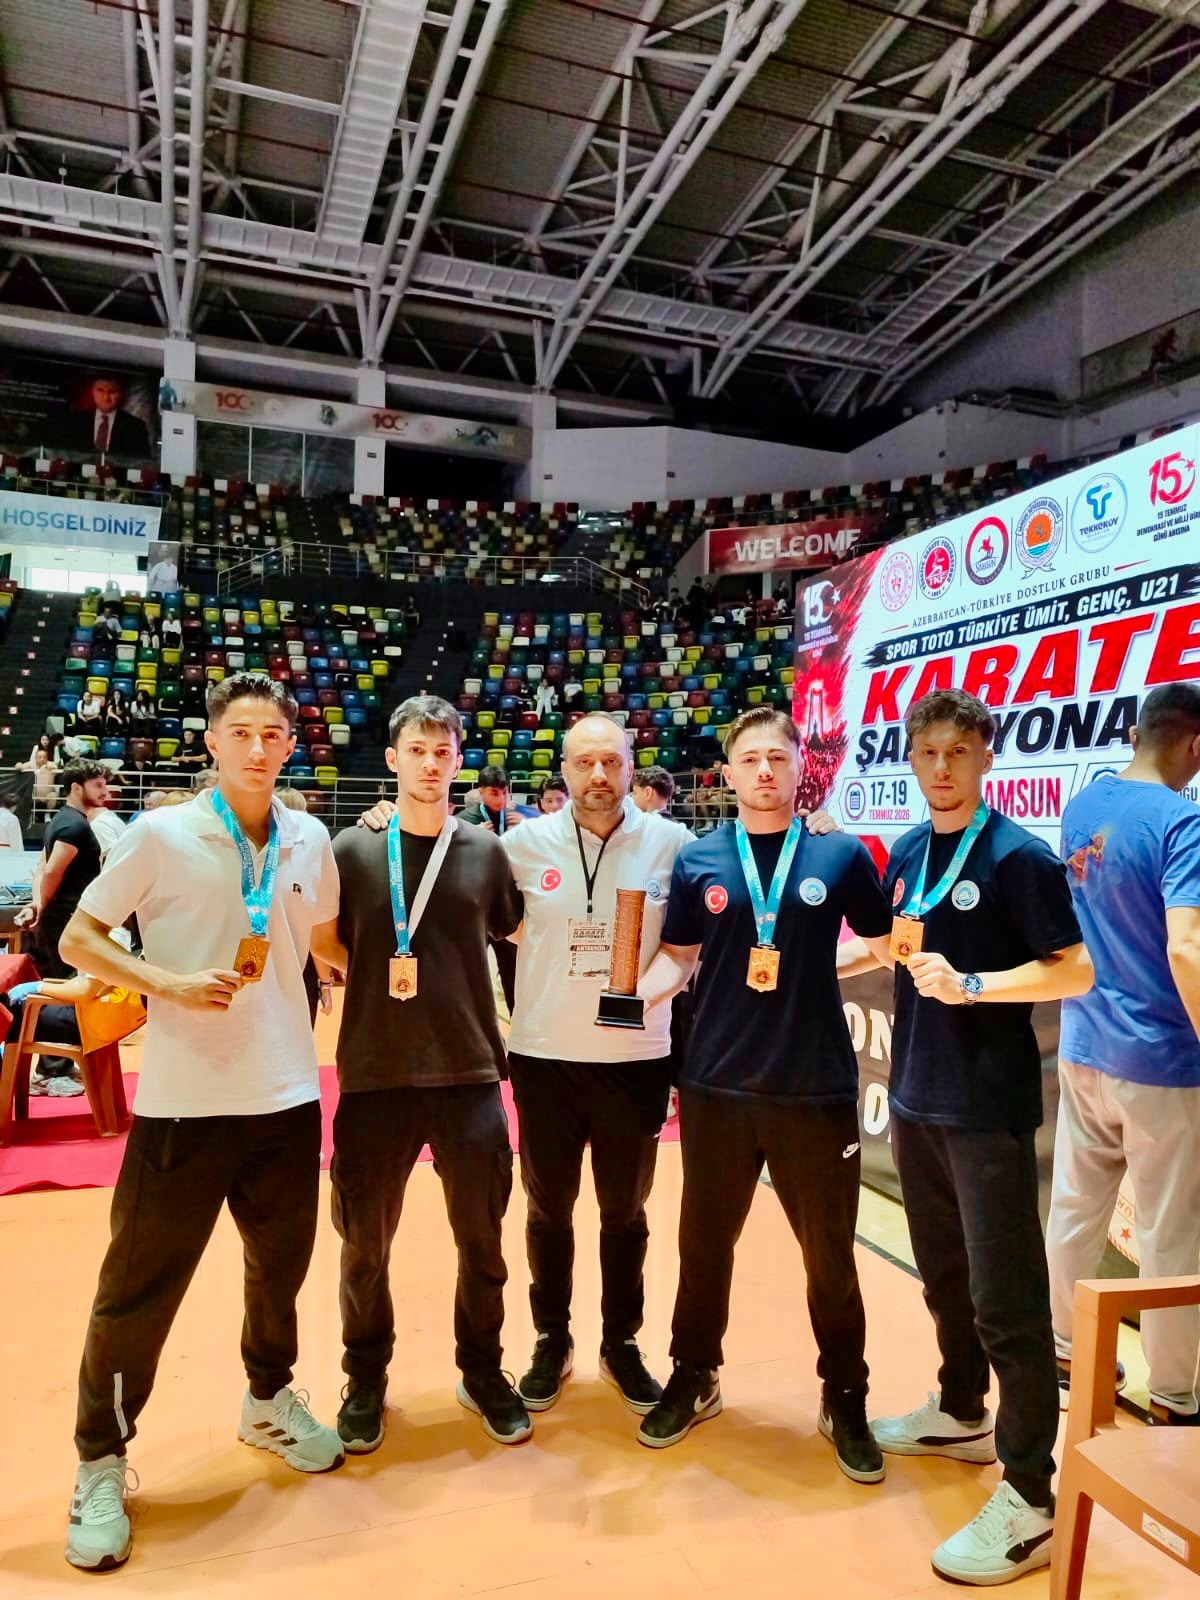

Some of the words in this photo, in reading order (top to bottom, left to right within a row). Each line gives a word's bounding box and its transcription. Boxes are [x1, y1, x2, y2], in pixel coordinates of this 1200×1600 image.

[3, 508, 147, 537] HOŞGELDİNİZ
[1165, 504, 1187, 517] TEMMUZ
[1017, 577, 1066, 600] DOSTLUK
[1070, 565, 1111, 586] GRUBU
[886, 639, 919, 661] SPOR
[921, 630, 954, 652] TOTO
[958, 613, 1020, 644] TÜRKİYE
[1024, 597, 1071, 628] ÜMİT,
[1076, 586, 1131, 613] GENÇ,
[1140, 573, 1180, 601] U21
[861, 603, 1200, 725] KARATE
[871, 780, 908, 806] 17-19
[984, 777, 1061, 818] AMSUN
[869, 810, 893, 820] TEMMUZ
[895, 809, 910, 820] 2026
